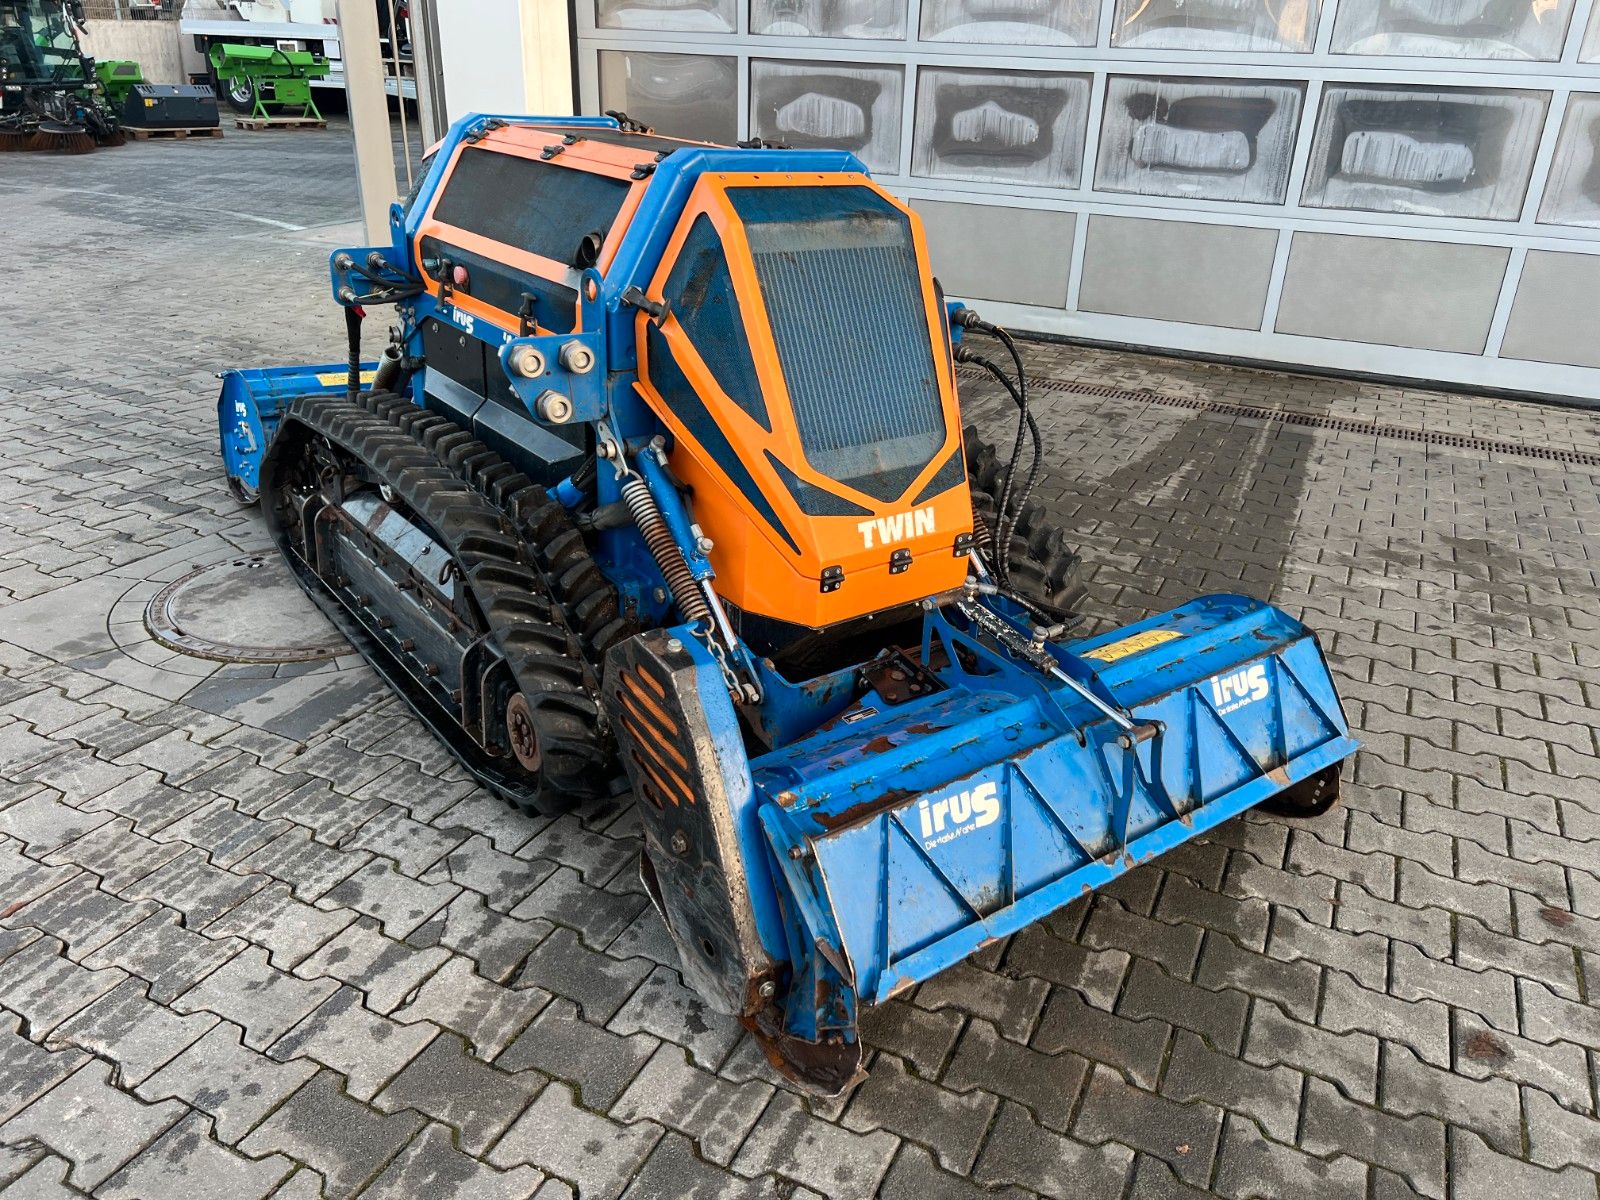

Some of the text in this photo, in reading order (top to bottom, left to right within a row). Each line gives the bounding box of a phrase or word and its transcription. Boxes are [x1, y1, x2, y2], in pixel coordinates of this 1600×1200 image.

[453, 306, 474, 334] irus
[857, 506, 936, 549] TWIN
[1211, 664, 1269, 707] irus
[919, 781, 1000, 839] irus
